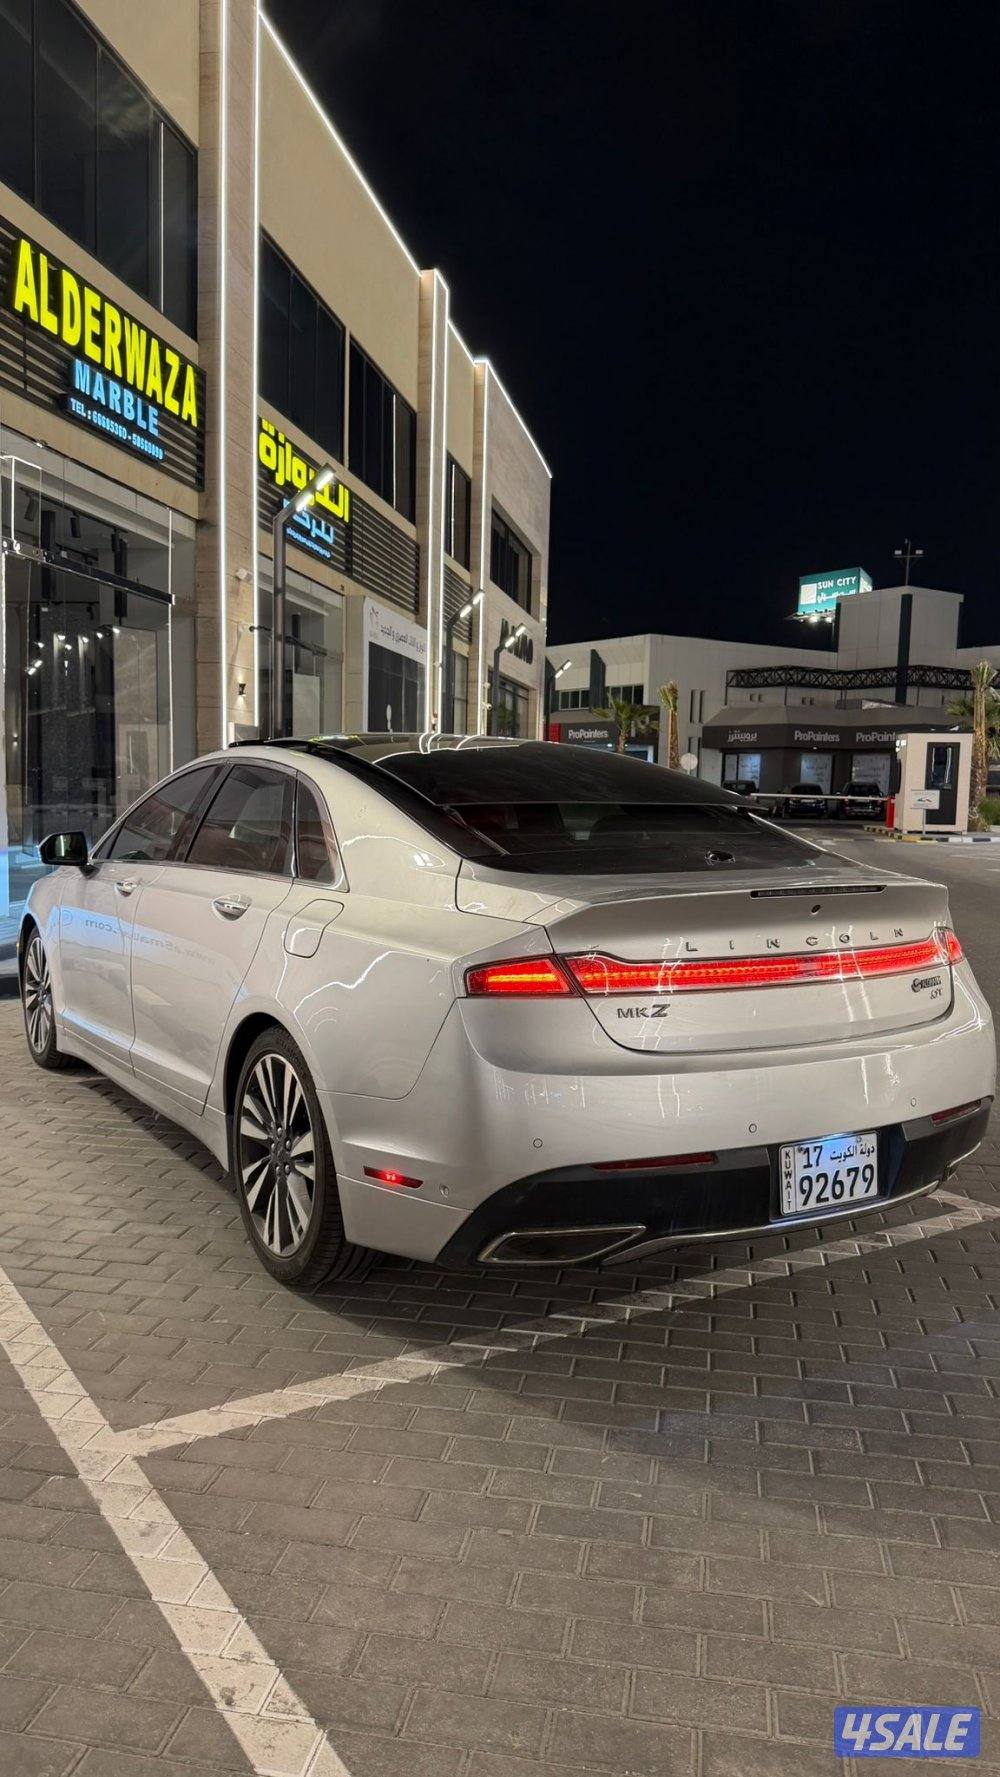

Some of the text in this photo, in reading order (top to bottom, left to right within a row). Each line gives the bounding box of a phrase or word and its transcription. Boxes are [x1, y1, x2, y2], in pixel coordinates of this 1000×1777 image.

[14, 238, 198, 427] ALDERWAZA
[70, 397, 86, 417] TEL
[75, 358, 159, 437] MARBLE
[816, 580, 834, 590] SUN
[836, 575, 857, 587] CITY
[568, 728, 609, 739] ProPainters
[794, 730, 840, 742] ProPainters
[855, 731, 896, 742] ProPaint
[685, 927, 904, 952] LINCOLN
[616, 1003, 671, 1019] MKZ
[802, 1145, 823, 1169] 17
[829, 1143, 875, 1163] دولة الكويت
[784, 1150, 793, 1210] KUWAIT
[800, 1164, 874, 1206] 92679
